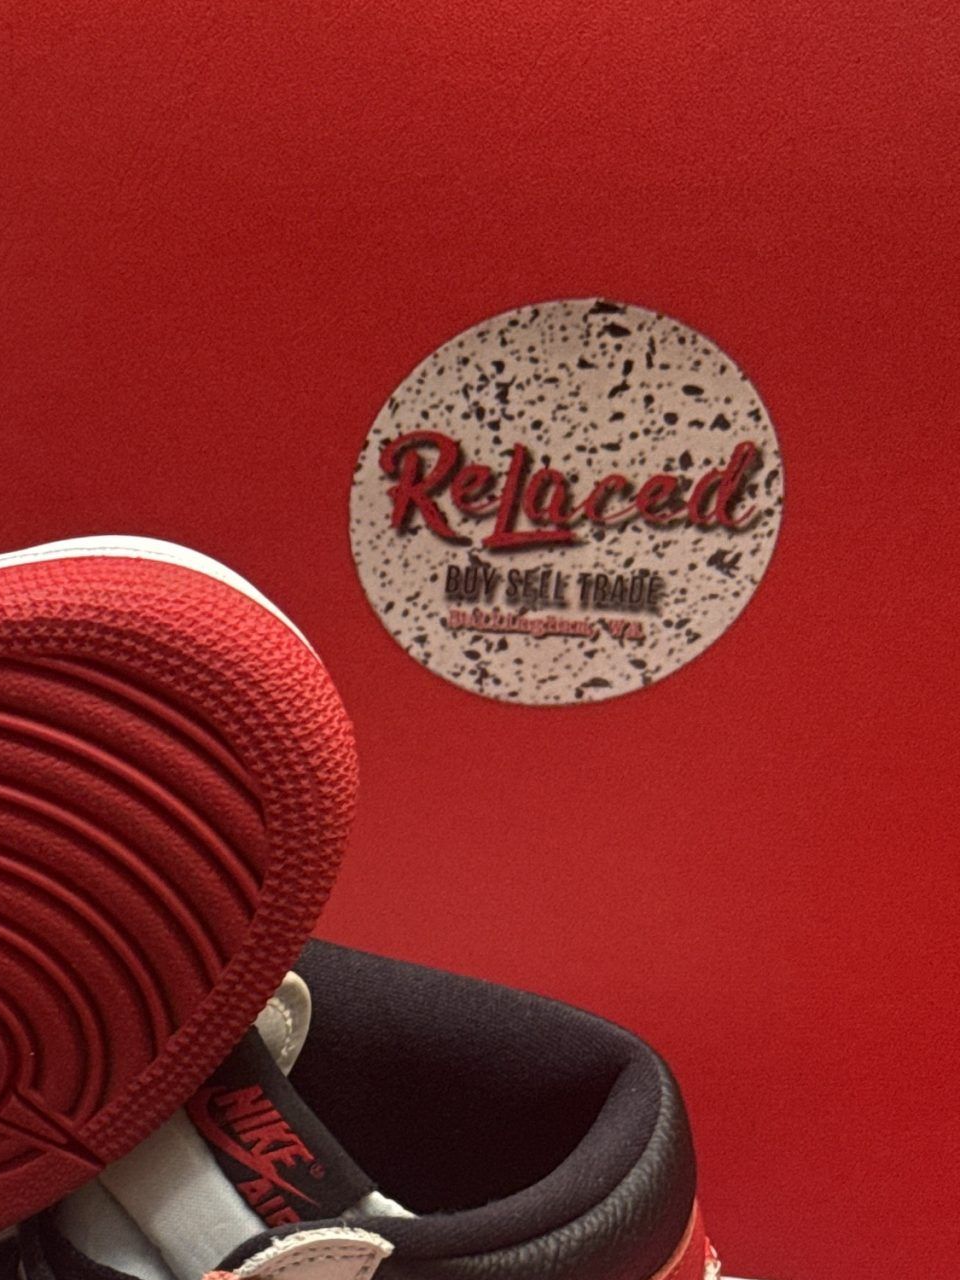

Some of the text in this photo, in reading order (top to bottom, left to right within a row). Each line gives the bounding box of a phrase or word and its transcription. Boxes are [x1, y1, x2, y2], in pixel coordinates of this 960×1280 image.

[444, 564, 664, 605] BUY SELL TRADE
[213, 1083, 315, 1168] NIKE
